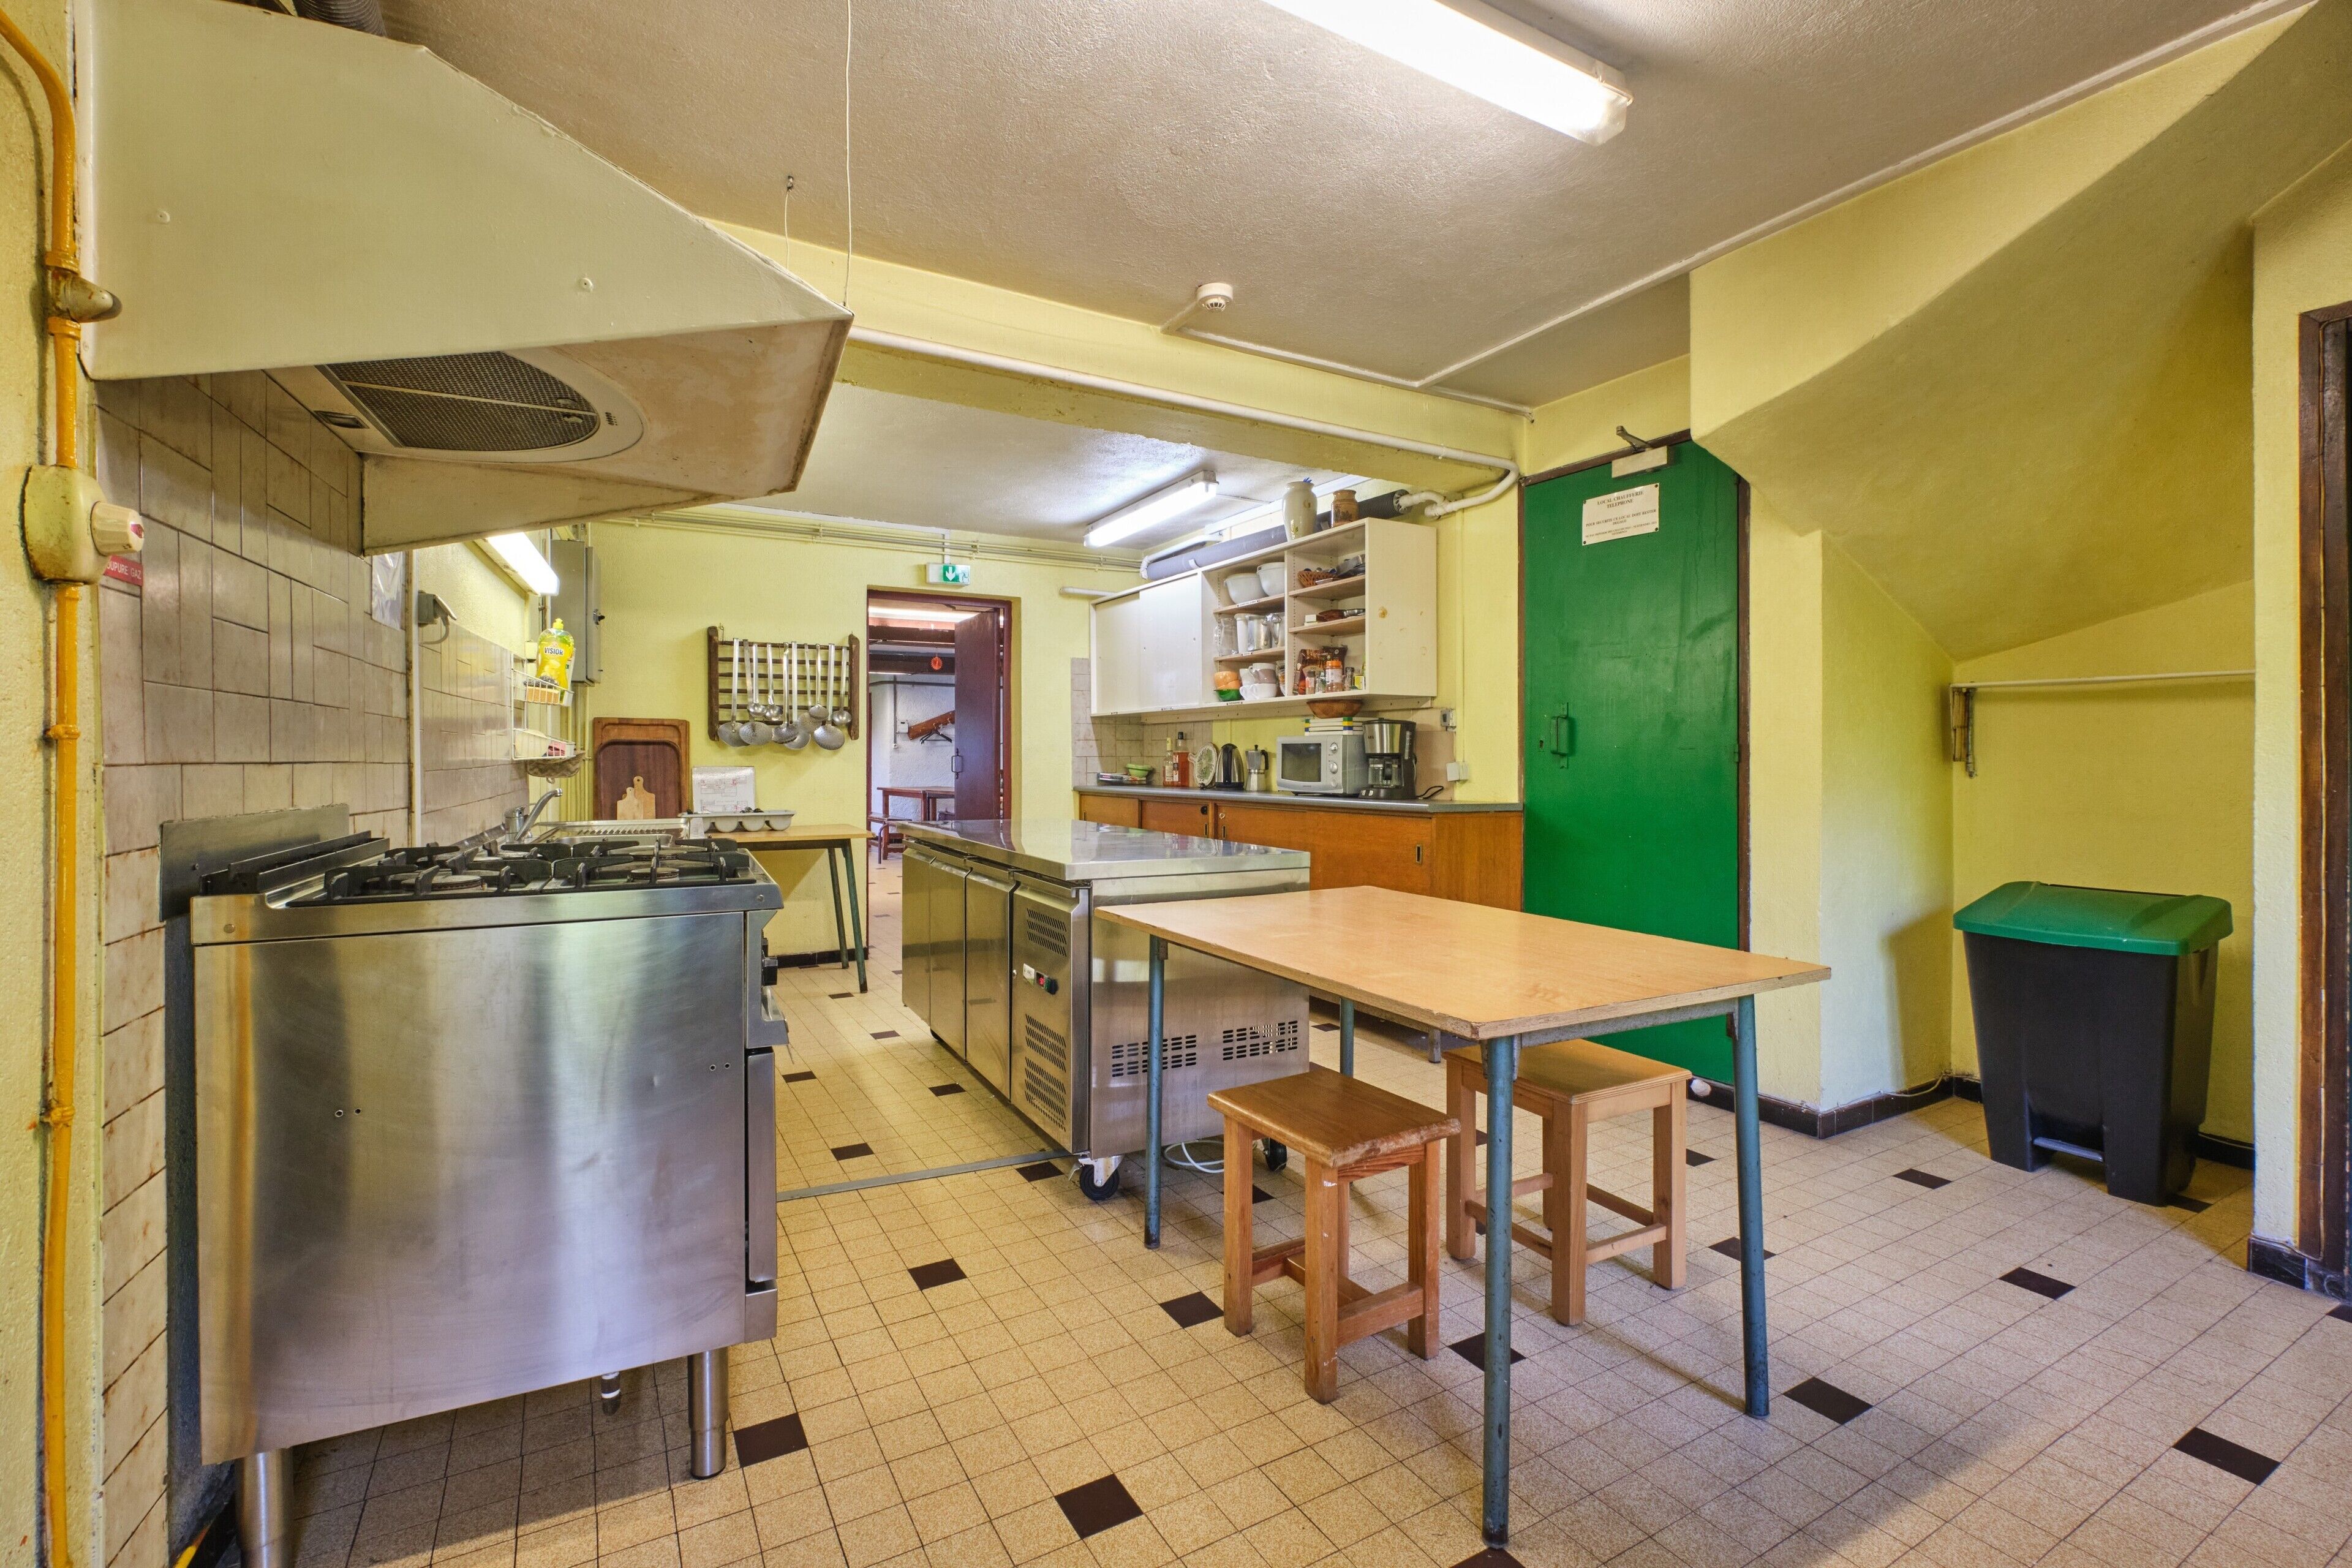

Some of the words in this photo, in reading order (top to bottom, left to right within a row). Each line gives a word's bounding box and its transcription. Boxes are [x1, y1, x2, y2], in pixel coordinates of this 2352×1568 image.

[1613, 491, 1644, 501] CHAUFFERIE
[1607, 499, 1633, 508] TELEPHONE
[107, 560, 129, 576] OUPURE
[130, 568, 141, 580] GAZ
